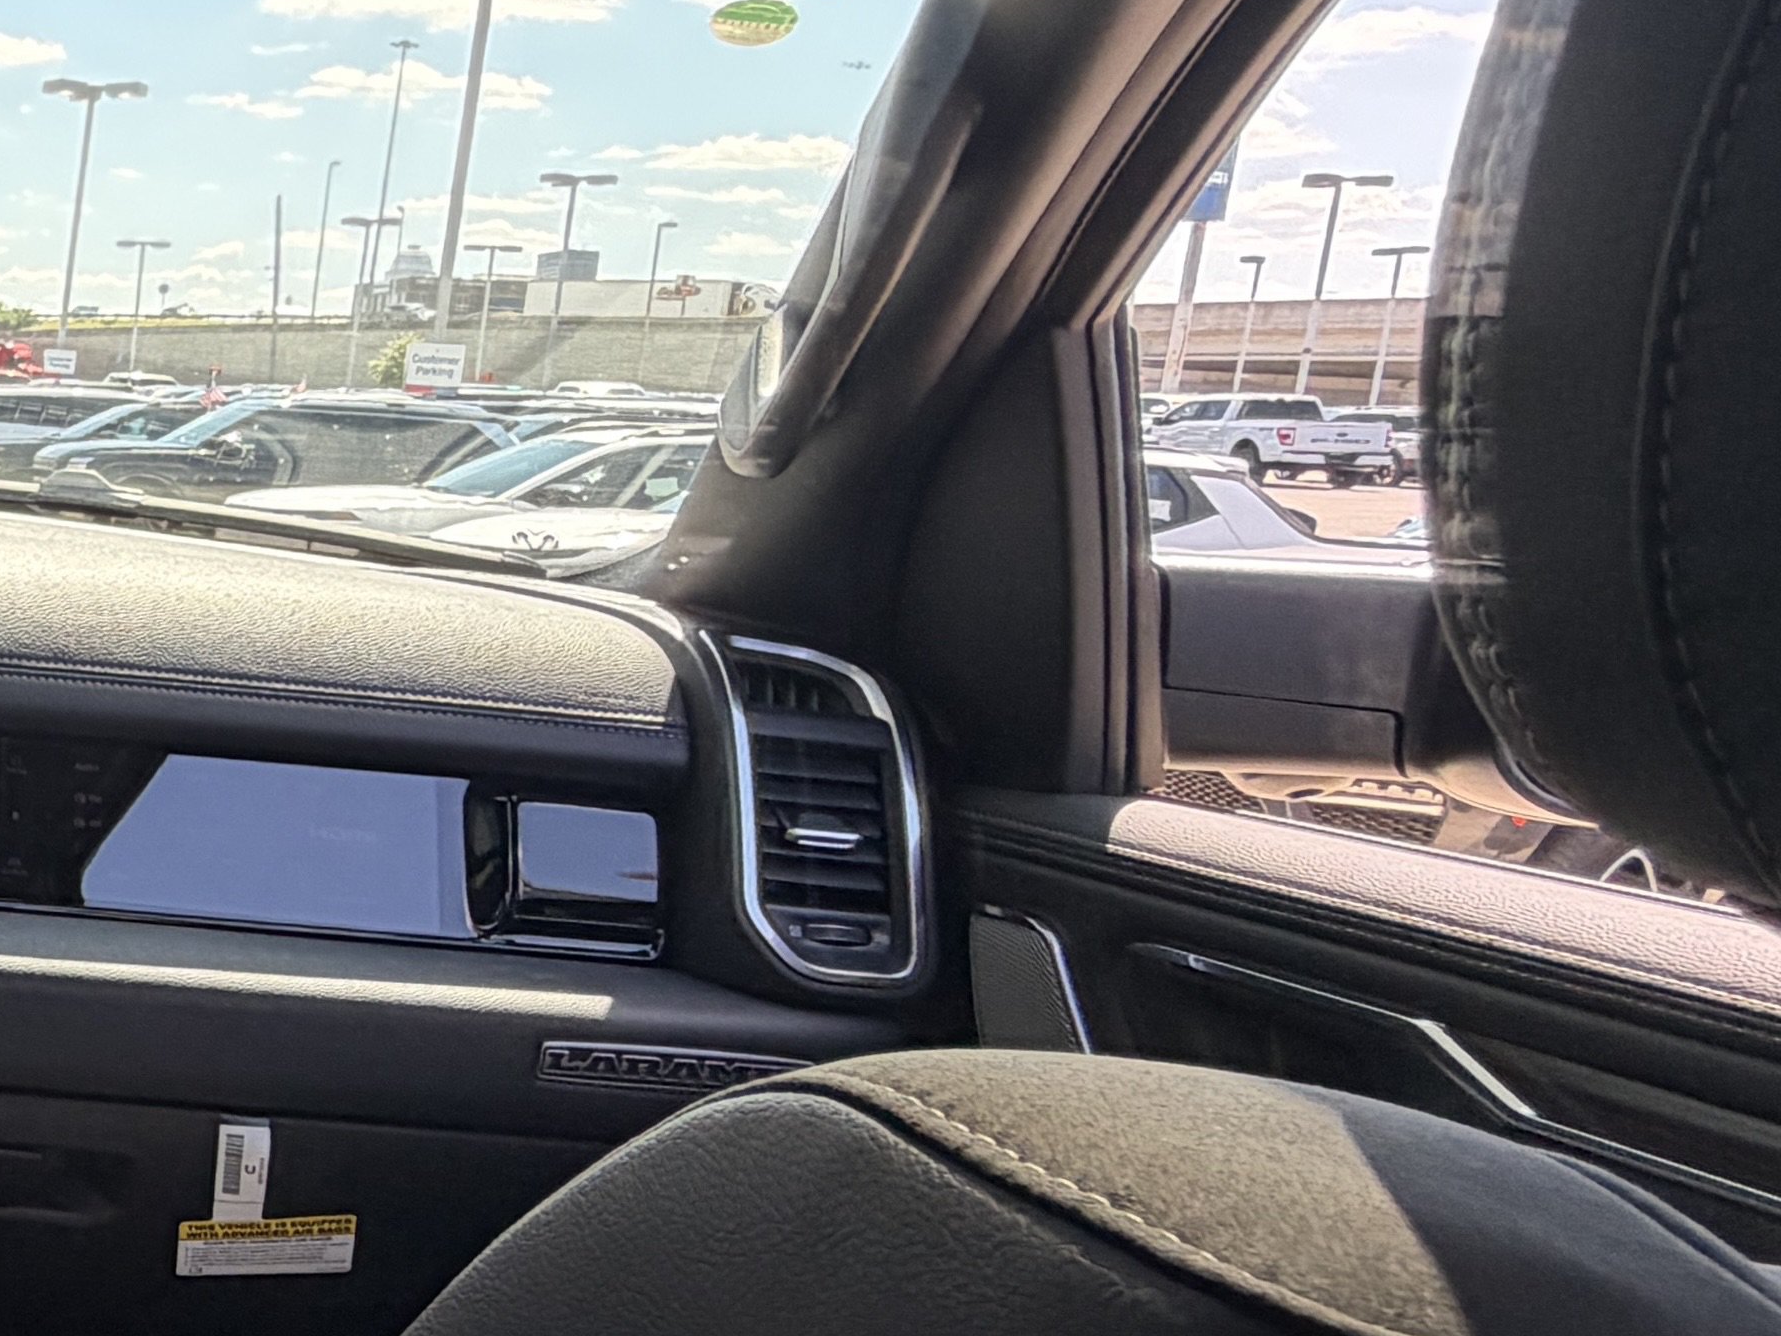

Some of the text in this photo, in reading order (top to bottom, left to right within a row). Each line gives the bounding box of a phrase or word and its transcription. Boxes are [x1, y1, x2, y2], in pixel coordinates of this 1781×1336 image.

[411, 354, 461, 365] Customer
[415, 365, 454, 379] Parking
[544, 1048, 787, 1085] LARAM
[219, 1221, 271, 1230] VEHICLE
[187, 1231, 219, 1240] WITH
[222, 1228, 290, 1239] ADVANCED
